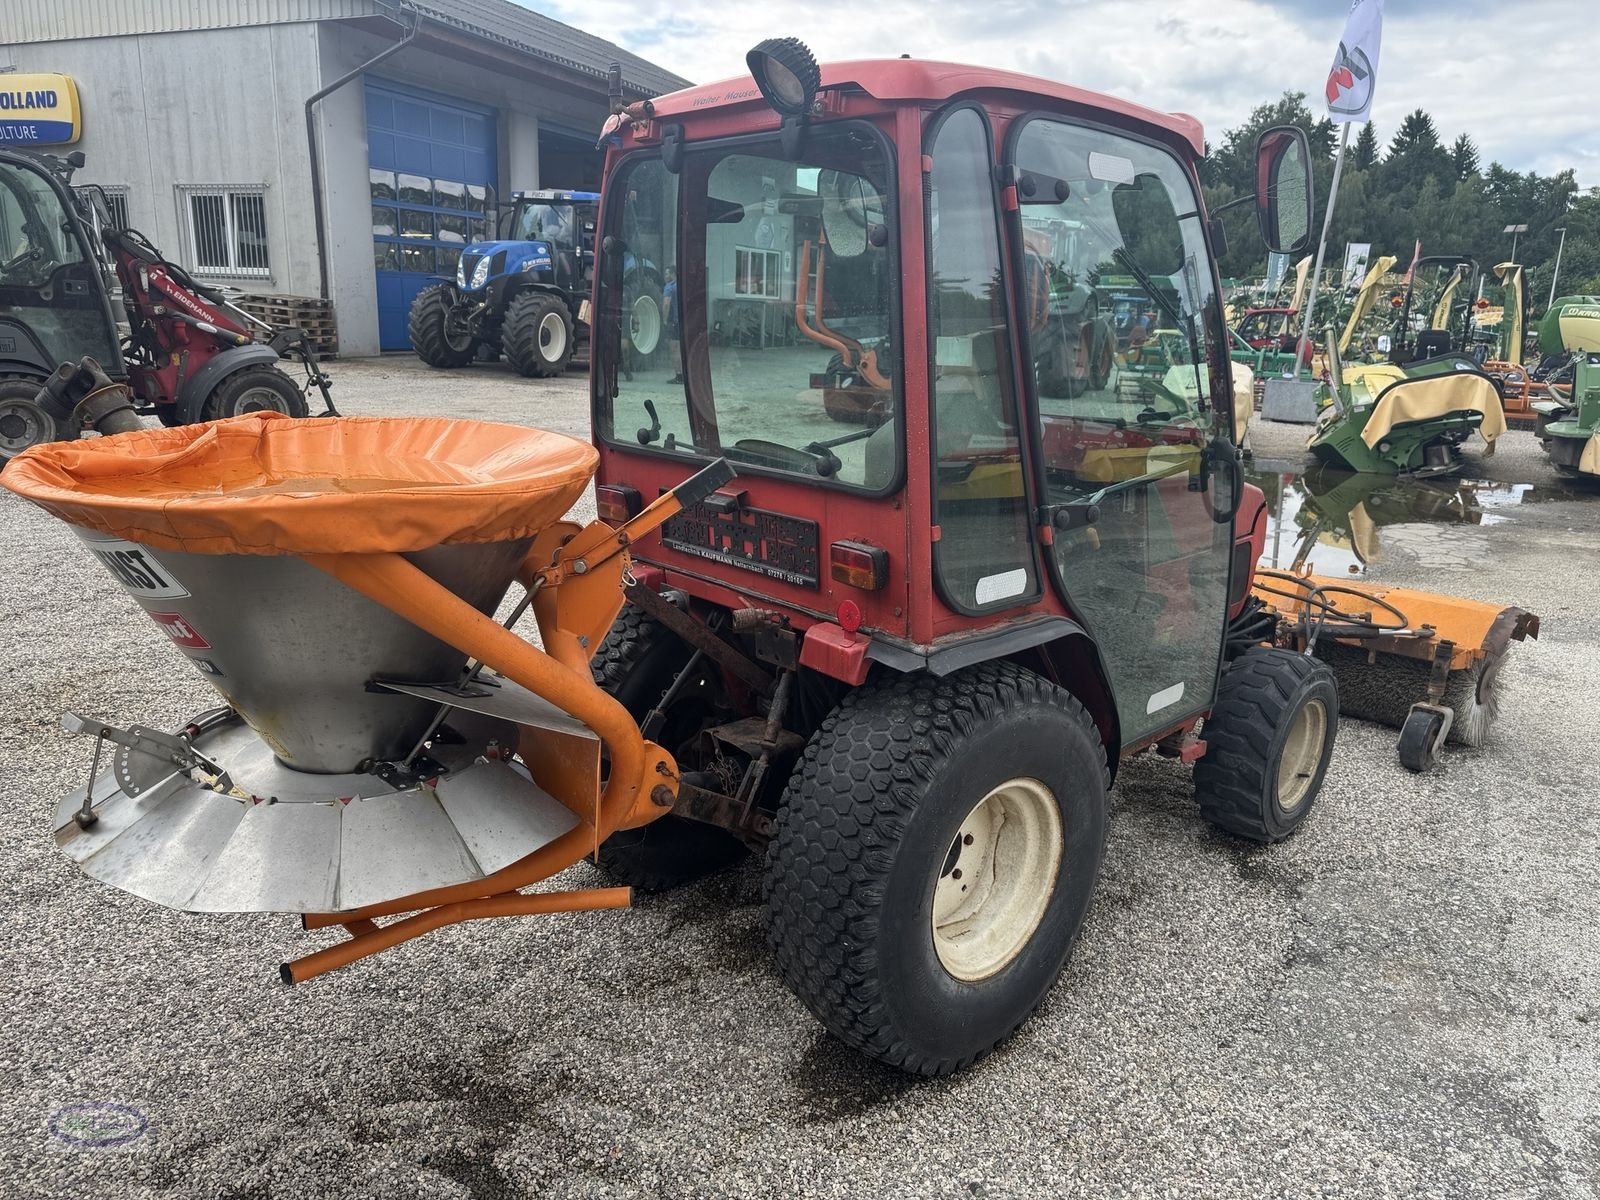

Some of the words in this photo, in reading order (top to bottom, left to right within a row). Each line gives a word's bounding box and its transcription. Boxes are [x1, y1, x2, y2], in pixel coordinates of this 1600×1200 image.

[693, 96, 720, 106] Walter
[724, 90, 758, 100] Mauser
[701, 552, 732, 564] KAUFMANN
